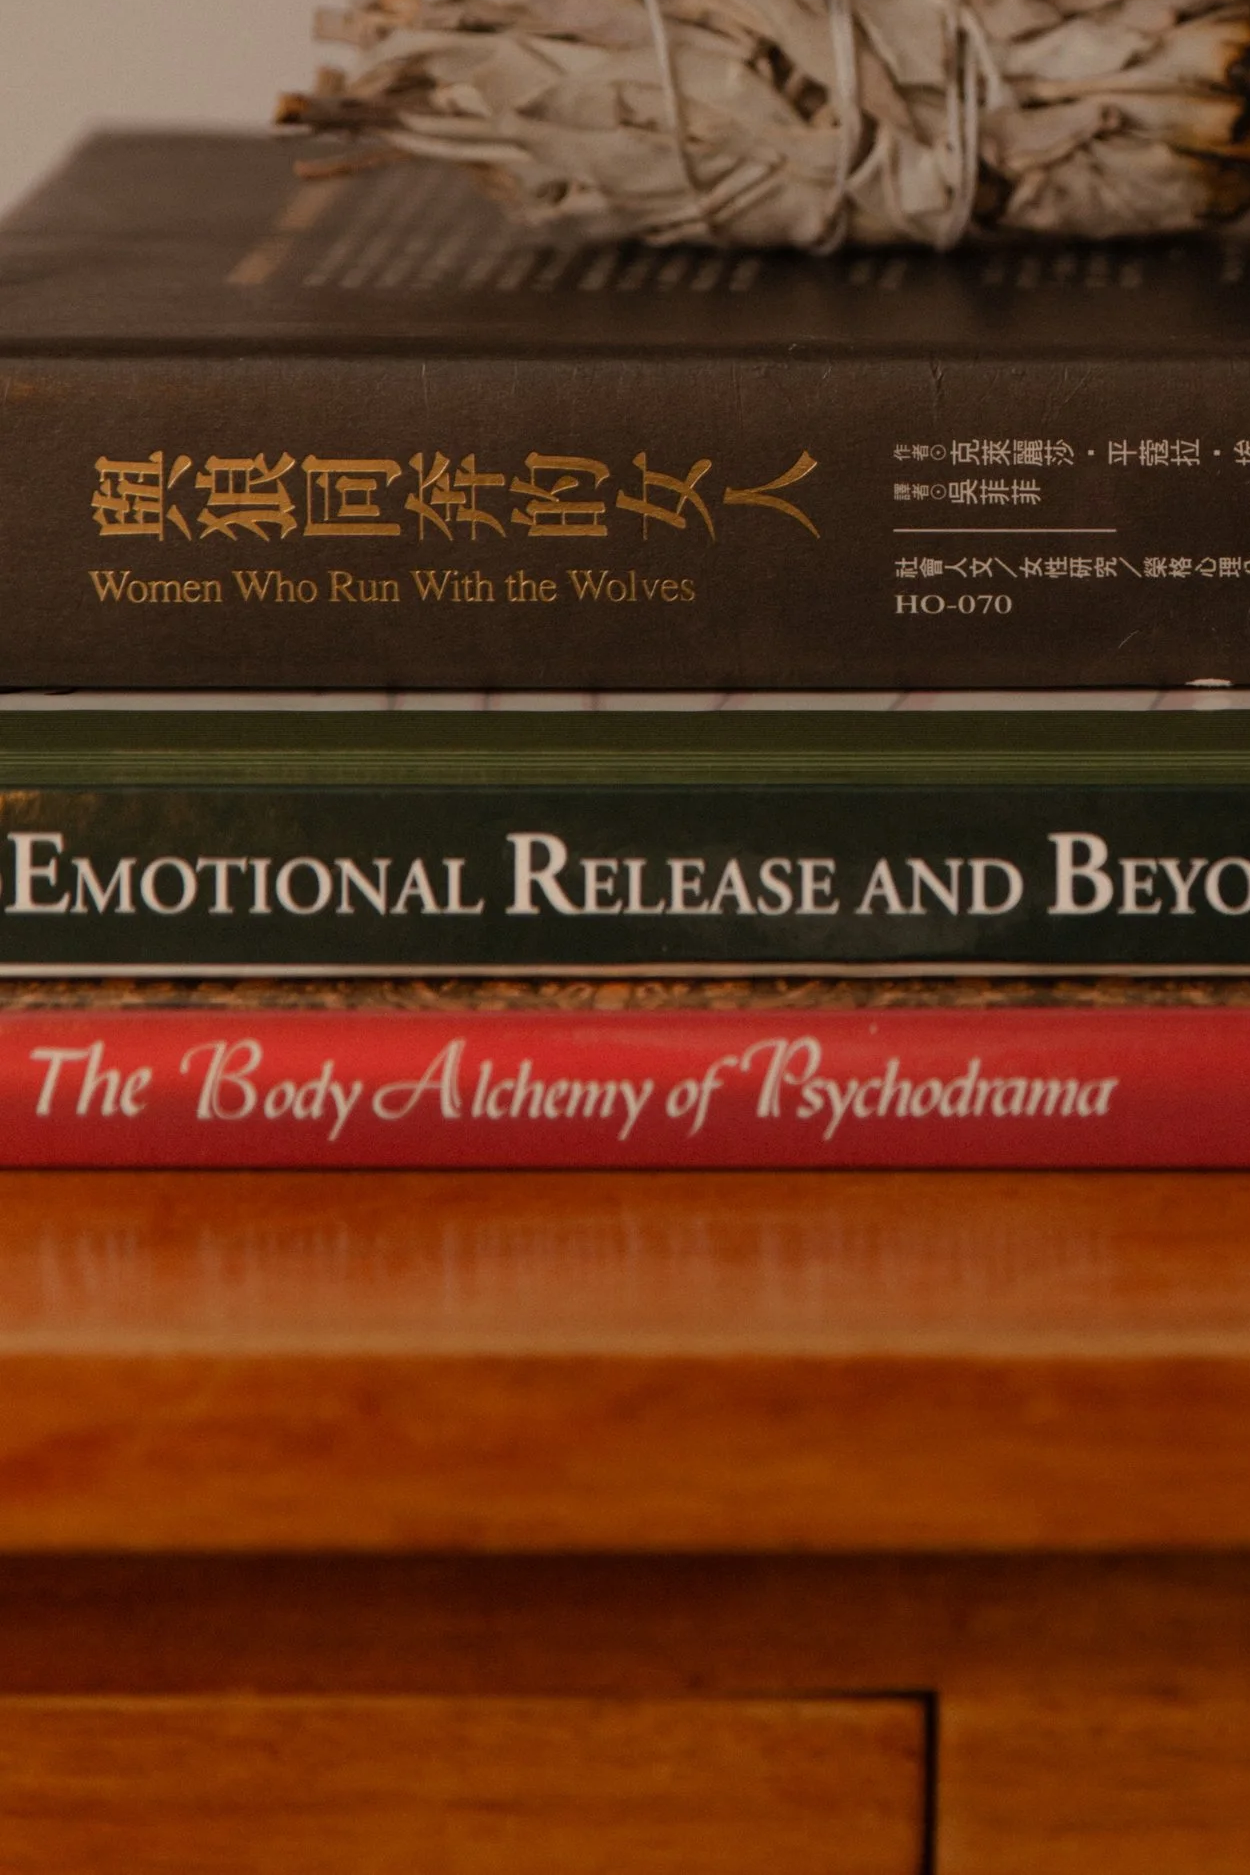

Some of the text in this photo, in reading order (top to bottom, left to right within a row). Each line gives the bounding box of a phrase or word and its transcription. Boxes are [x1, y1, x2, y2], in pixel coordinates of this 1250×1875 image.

[90, 449, 820, 543] 與狼同奔的女人
[87, 569, 696, 604] Women Who Run With the Wolves
[894, 593, 1013, 616] HO-070
[0, 831, 484, 916] EMOTIONAL
[505, 831, 840, 916] RELEASE
[855, 857, 1025, 916] AND
[29, 1037, 1119, 1141] The Body Alchemy of Psychodrama
